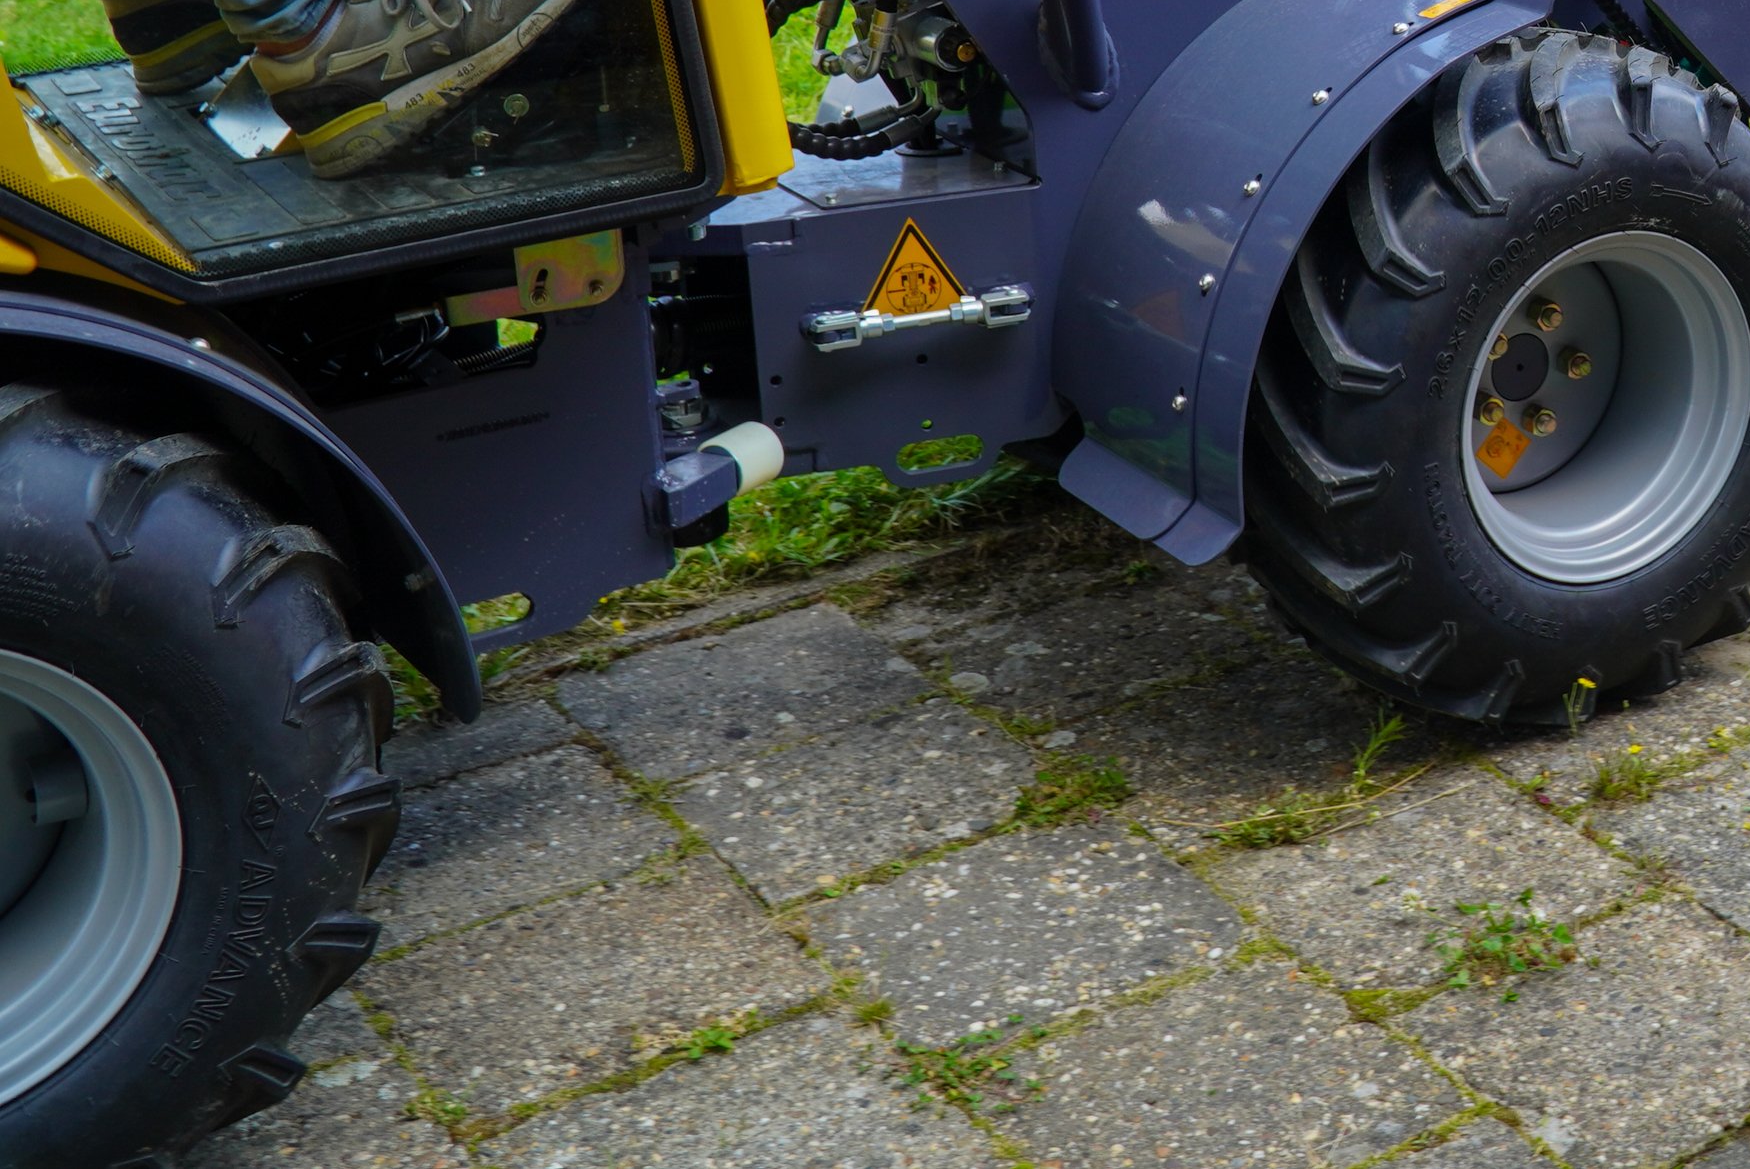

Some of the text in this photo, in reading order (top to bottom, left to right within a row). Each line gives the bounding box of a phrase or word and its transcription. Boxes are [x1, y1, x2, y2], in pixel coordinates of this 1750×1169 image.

[457, 63, 476, 78] 483
[404, 92, 424, 109] 483
[150, 858, 278, 1078] ADVANCE
